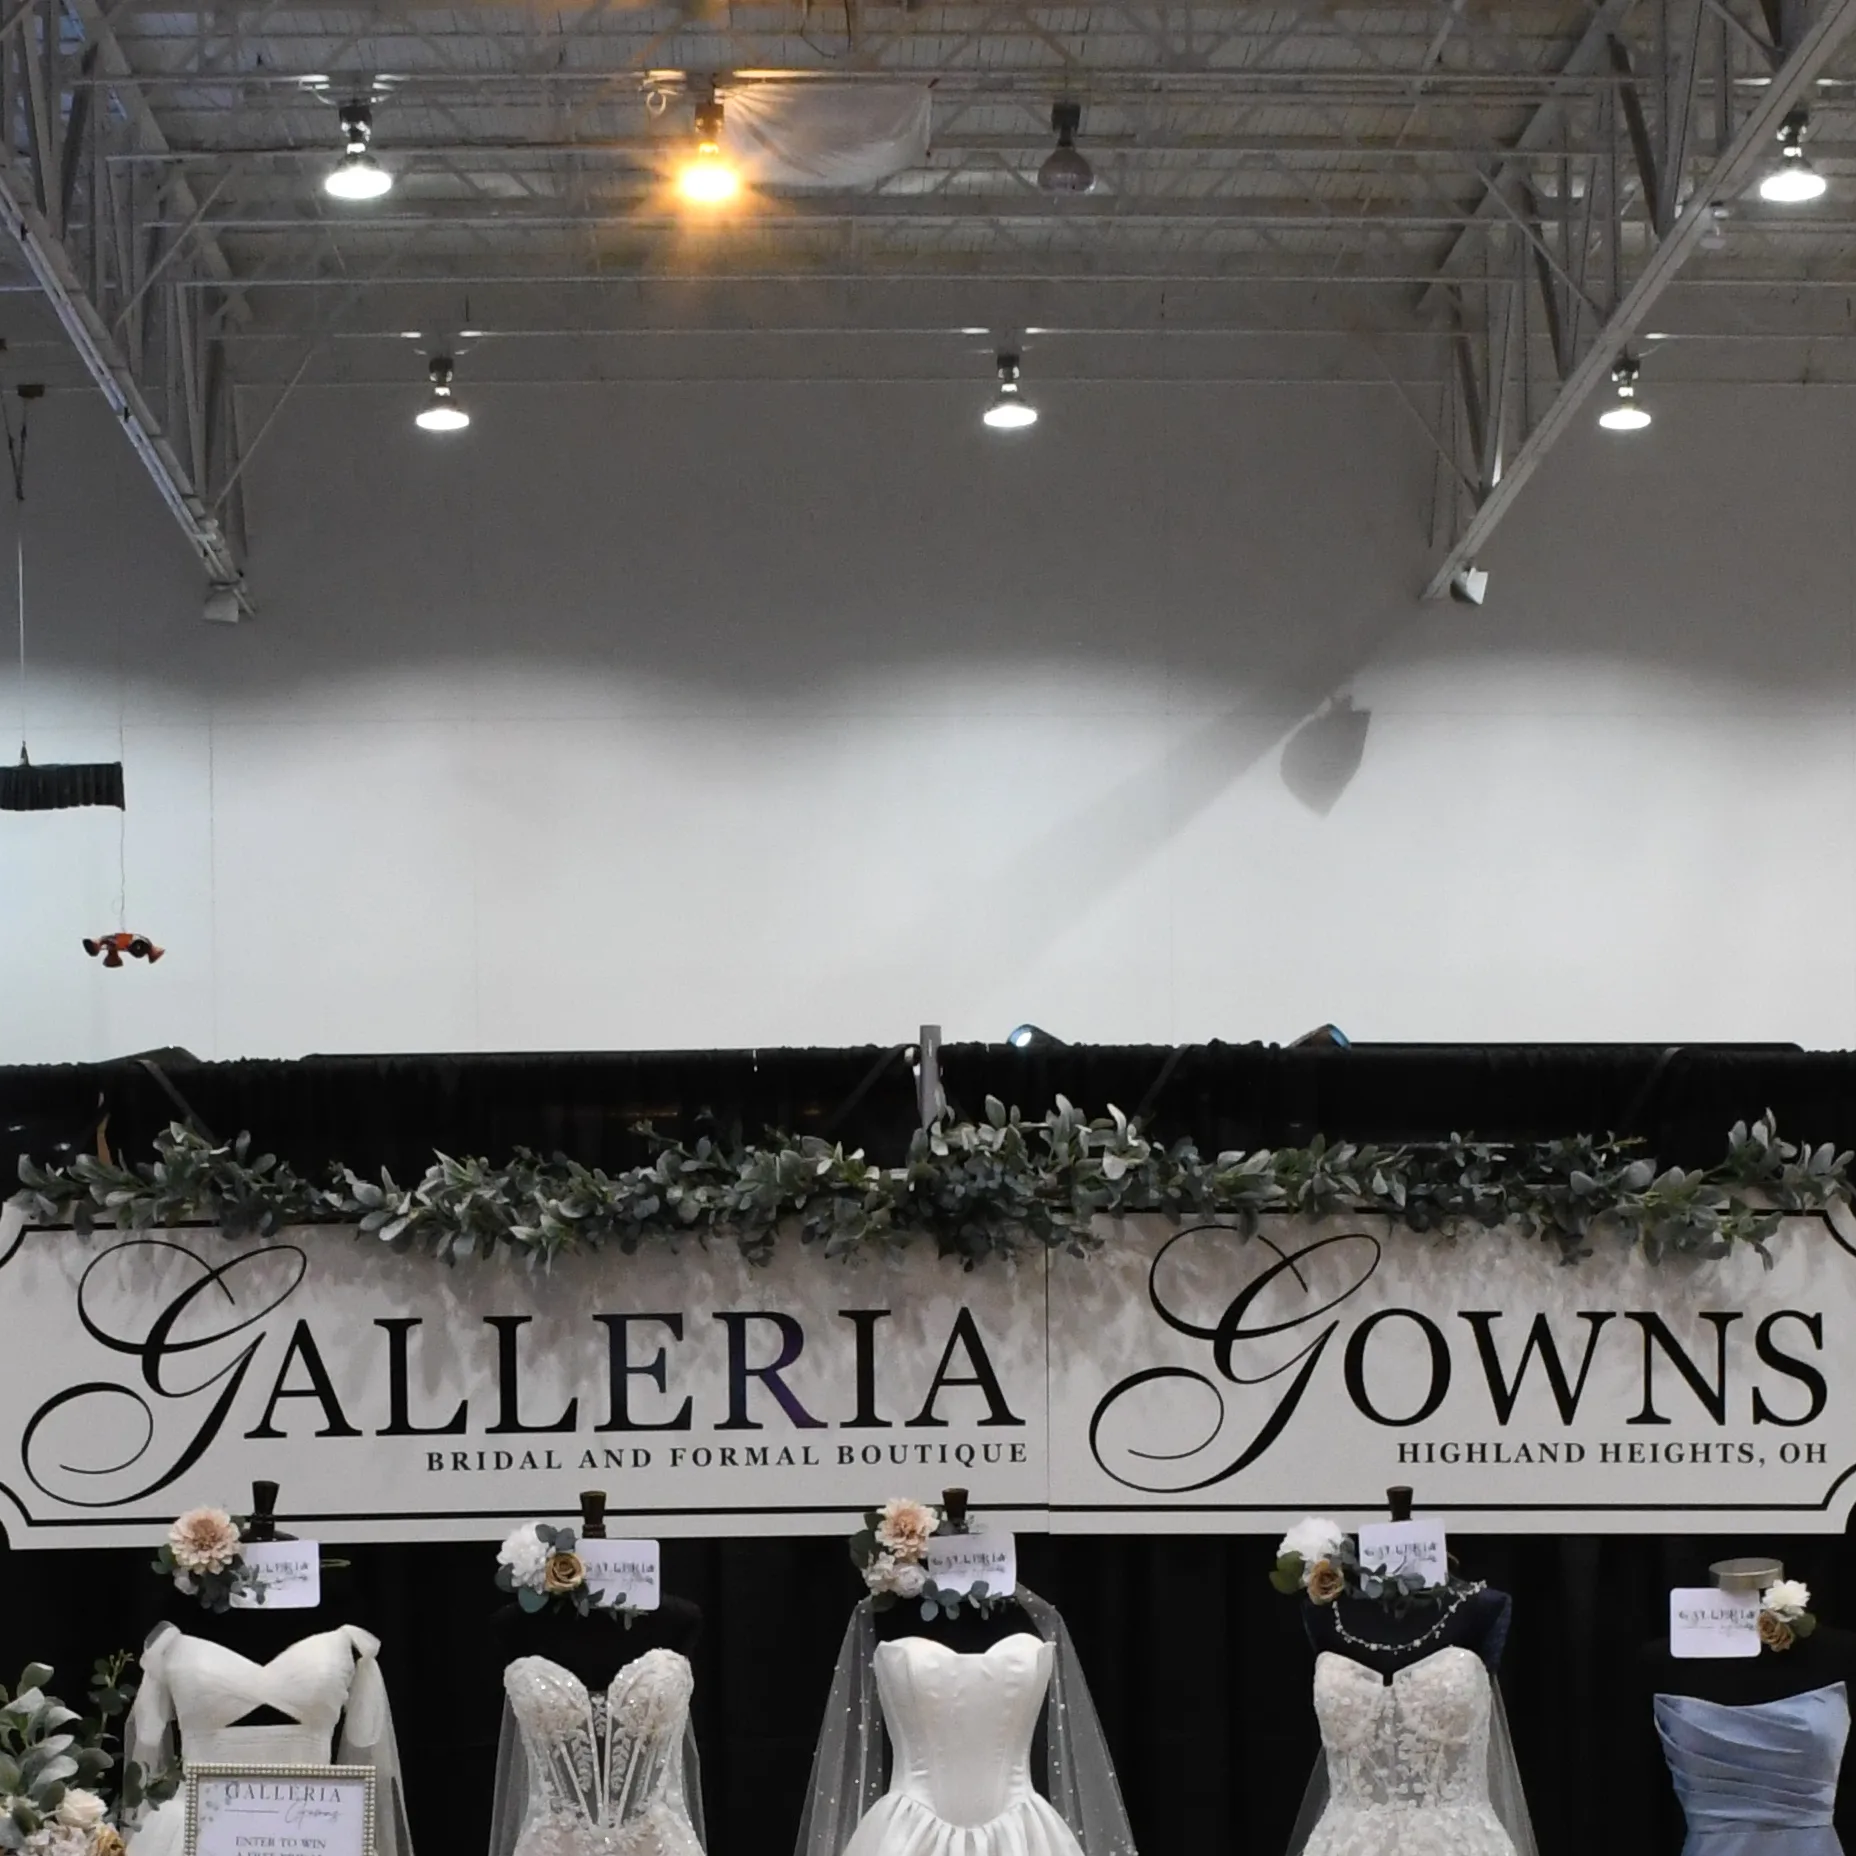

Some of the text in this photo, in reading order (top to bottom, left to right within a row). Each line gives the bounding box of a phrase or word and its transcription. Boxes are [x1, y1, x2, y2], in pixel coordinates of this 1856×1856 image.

[20, 1224, 1830, 1508] GALLERIA GOWNS
[426, 1442, 1028, 1472] BRIDAL AND FORMAL BOUTIQUE
[1397, 1442, 1828, 1468] HIGHLAND HEIGHTS, OH
[224, 1781, 342, 1804] GALLERIA
[235, 1836, 327, 1850] ENTER TO WIN
